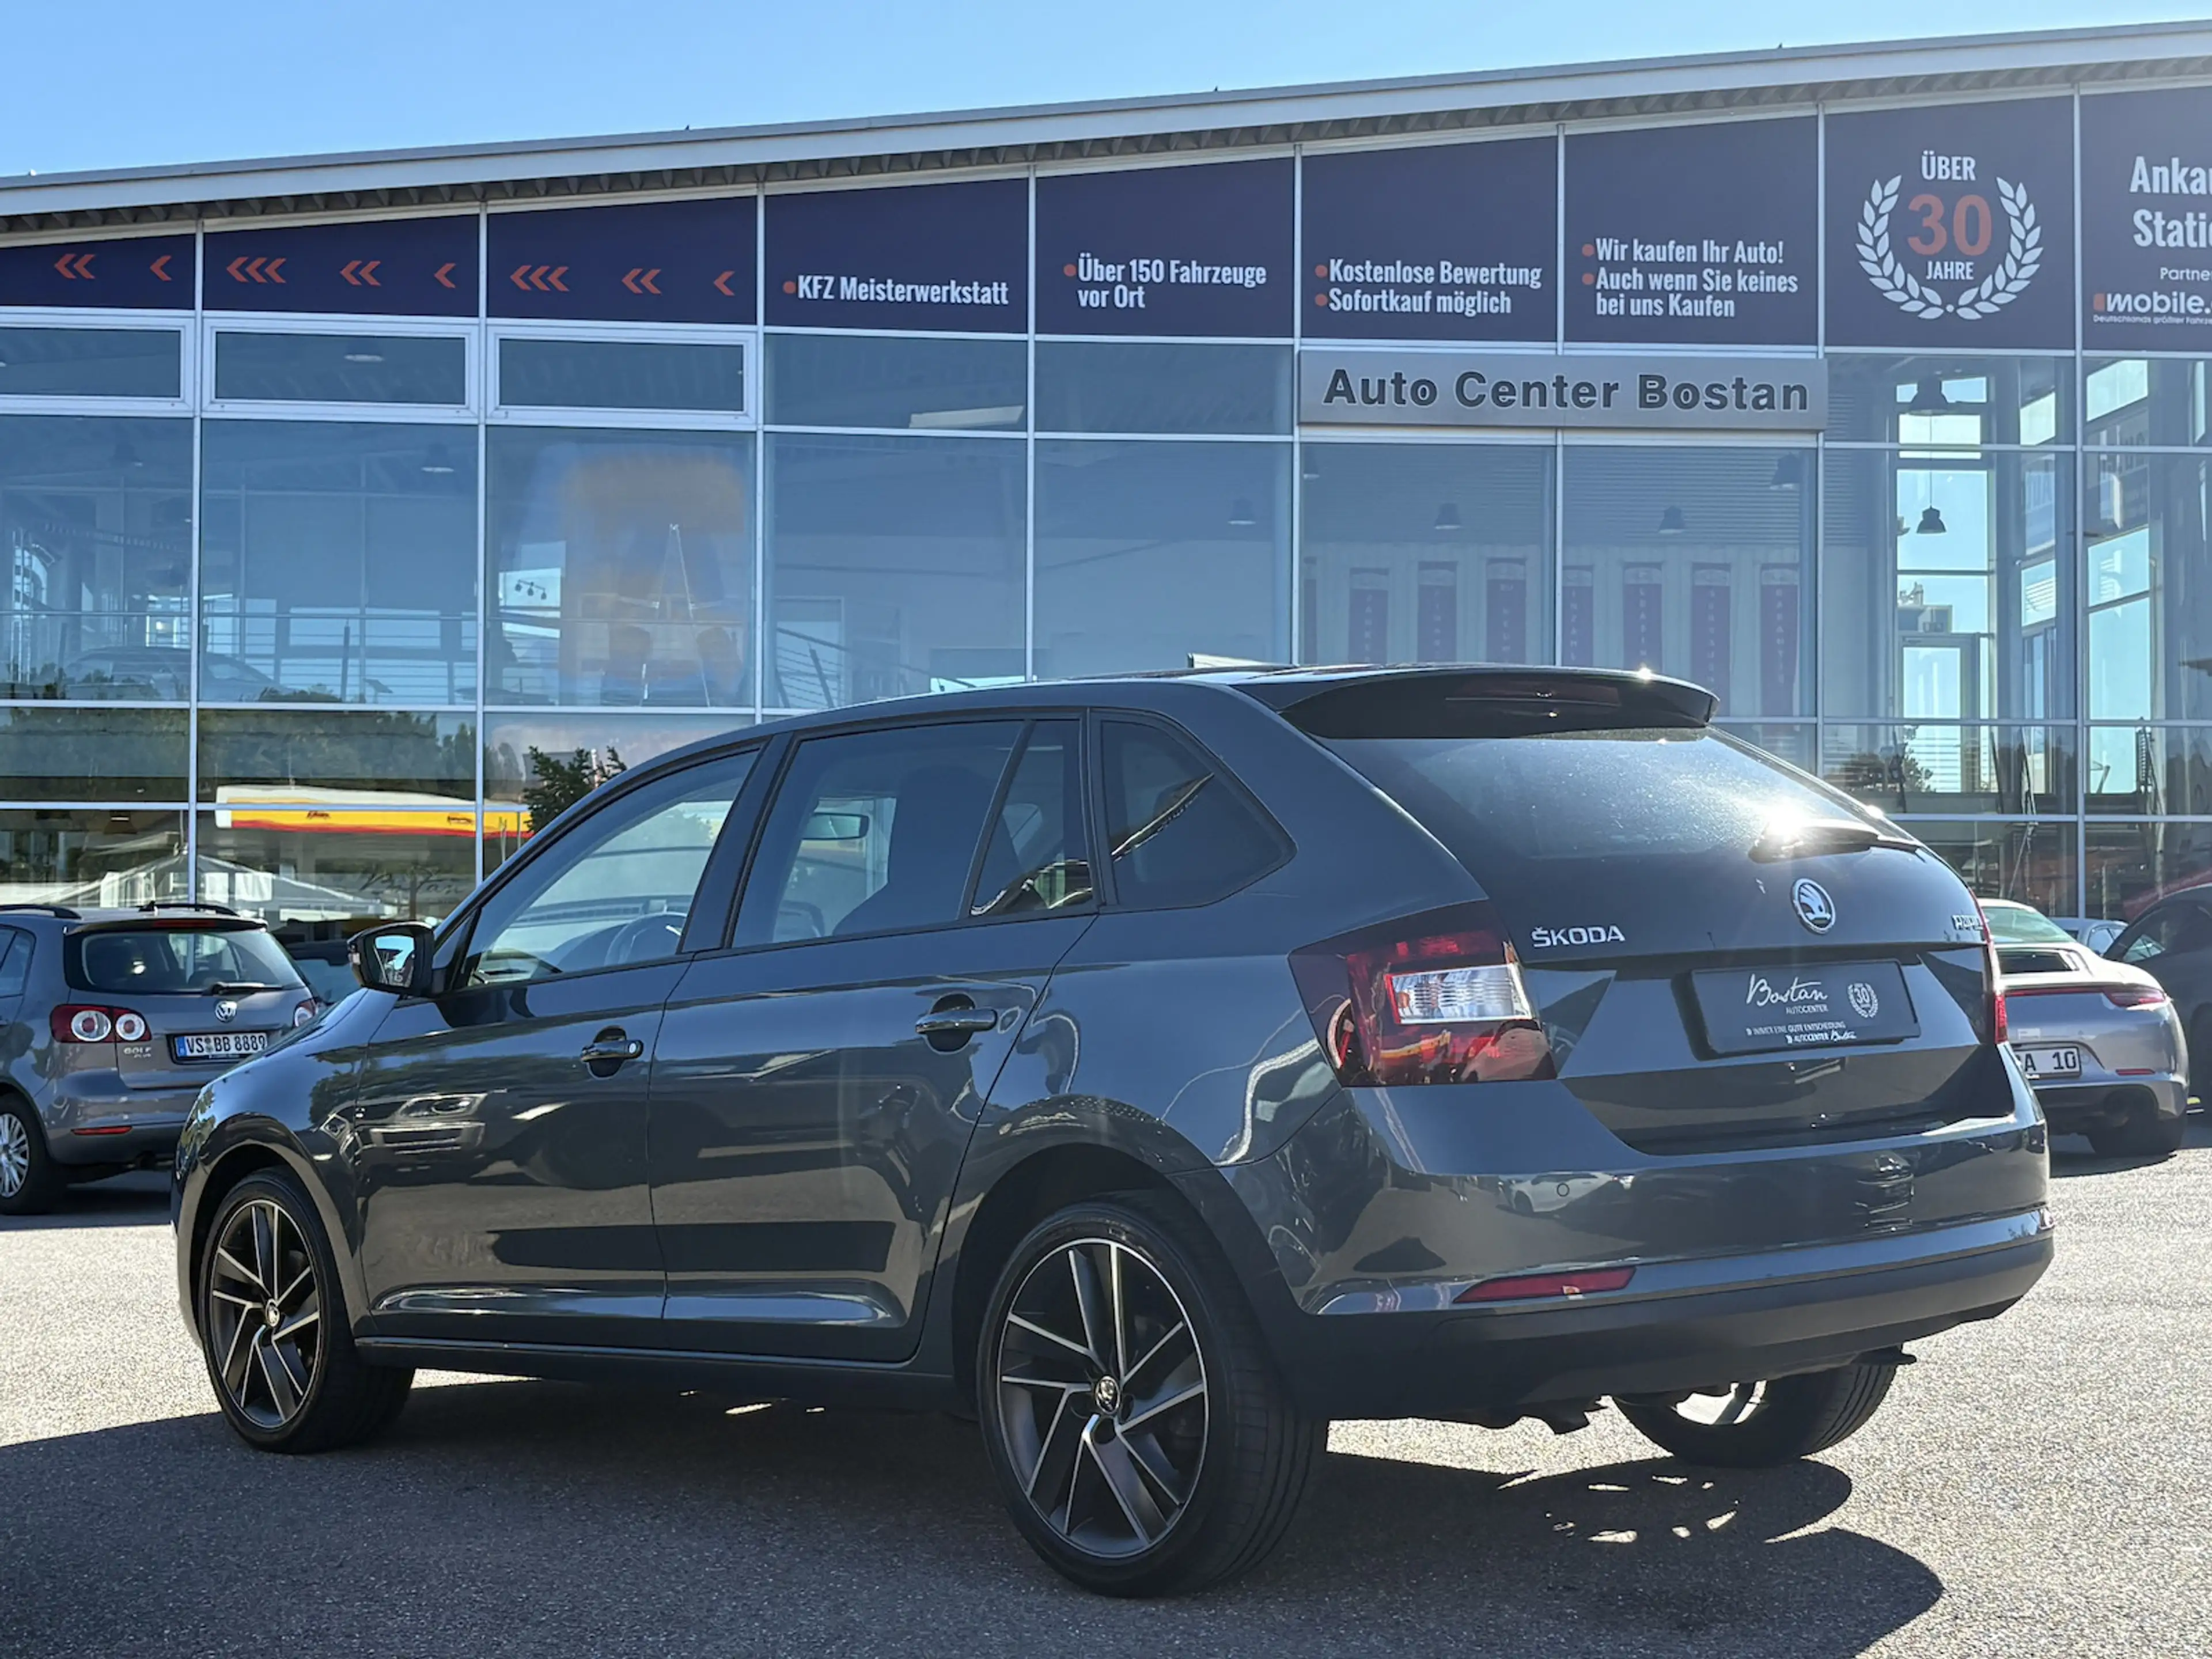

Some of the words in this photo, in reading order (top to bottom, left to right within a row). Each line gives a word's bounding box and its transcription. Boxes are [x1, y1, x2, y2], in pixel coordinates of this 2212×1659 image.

[1921, 150, 1976, 181] ÜBER
[1908, 194, 1993, 256] 30
[2133, 209, 2212, 248] Stati
[1596, 238, 1628, 262] Wir
[1633, 239, 1696, 262] kaufen
[1703, 240, 1729, 263] Ihr
[1733, 241, 1784, 263] Auto!
[1078, 252, 1125, 282] Über
[1130, 259, 1164, 283] 150
[1169, 260, 1266, 287] Fahrzeuge
[1330, 259, 1434, 283] Kostenlose
[1440, 261, 1542, 289] Bewertung
[1596, 267, 1643, 290] Auch
[1649, 273, 1696, 291] wenn
[1703, 268, 1732, 291] Sie
[1737, 270, 1798, 293] keines
[1926, 261, 1974, 280] JAHRE
[798, 275, 834, 300] KFZ
[840, 276, 1009, 304] Meisterwerkstatt
[1078, 289, 1109, 307] vor
[1115, 285, 1145, 308] Ort
[1329, 288, 1431, 312] Sofortkauf
[1437, 290, 1511, 317] möglich
[1596, 293, 1624, 315] bei
[1630, 298, 1663, 316] uns
[1669, 294, 1734, 317] Kaufen
[2107, 291, 2212, 314] mobile.
[1323, 369, 1438, 407] Auto
[1455, 370, 1620, 410] Center
[1638, 373, 1808, 412] Bostan
[1532, 925, 1626, 948] ŠKODA
[1746, 974, 1828, 1006] Bostan
[1854, 987, 1870, 1005] 30
[1786, 1004, 1829, 1014] AUTOCENTER
[123, 1046, 152, 1055] GOLF
[187, 1037, 204, 1054] VS
[214, 1036, 231, 1052] BB
[2052, 1051, 2077, 1070] 10
